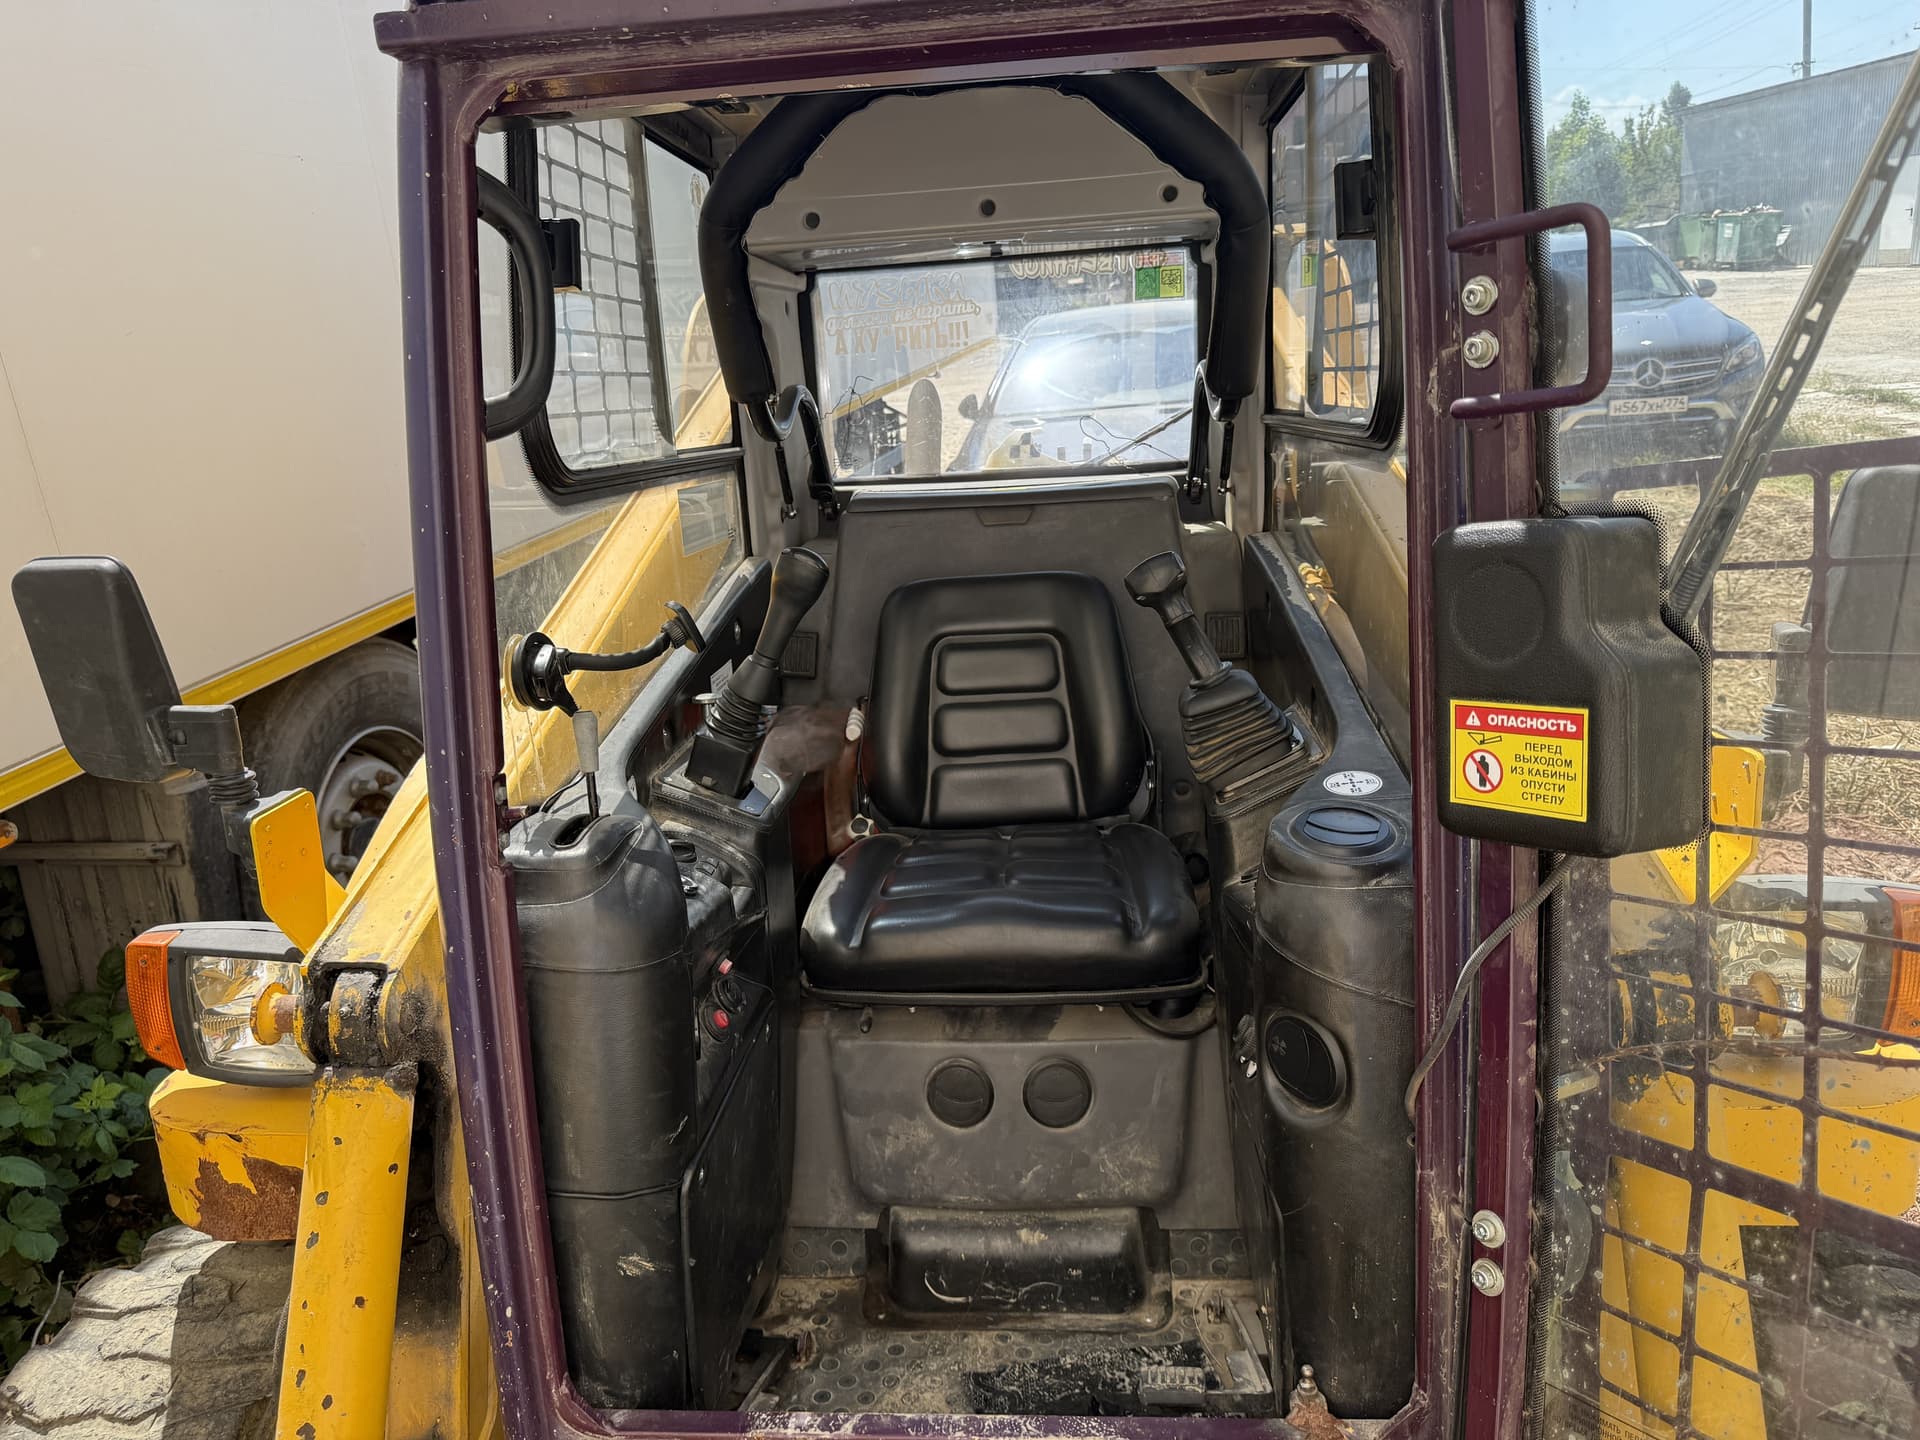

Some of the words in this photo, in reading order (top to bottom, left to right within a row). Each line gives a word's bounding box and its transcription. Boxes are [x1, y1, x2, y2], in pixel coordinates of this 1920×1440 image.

[1487, 713, 1577, 733] ОПАСНОСТЬ
[1525, 742, 1562, 755] ПЕРЕД
[1514, 754, 1573, 768] ВЫХОДОМ
[1510, 766, 1525, 776] ИЗ
[1528, 767, 1577, 781] КАБИНЫ
[1520, 780, 1566, 793] ОПУСТИ
[1521, 791, 1565, 806] СТРЕЛУ
